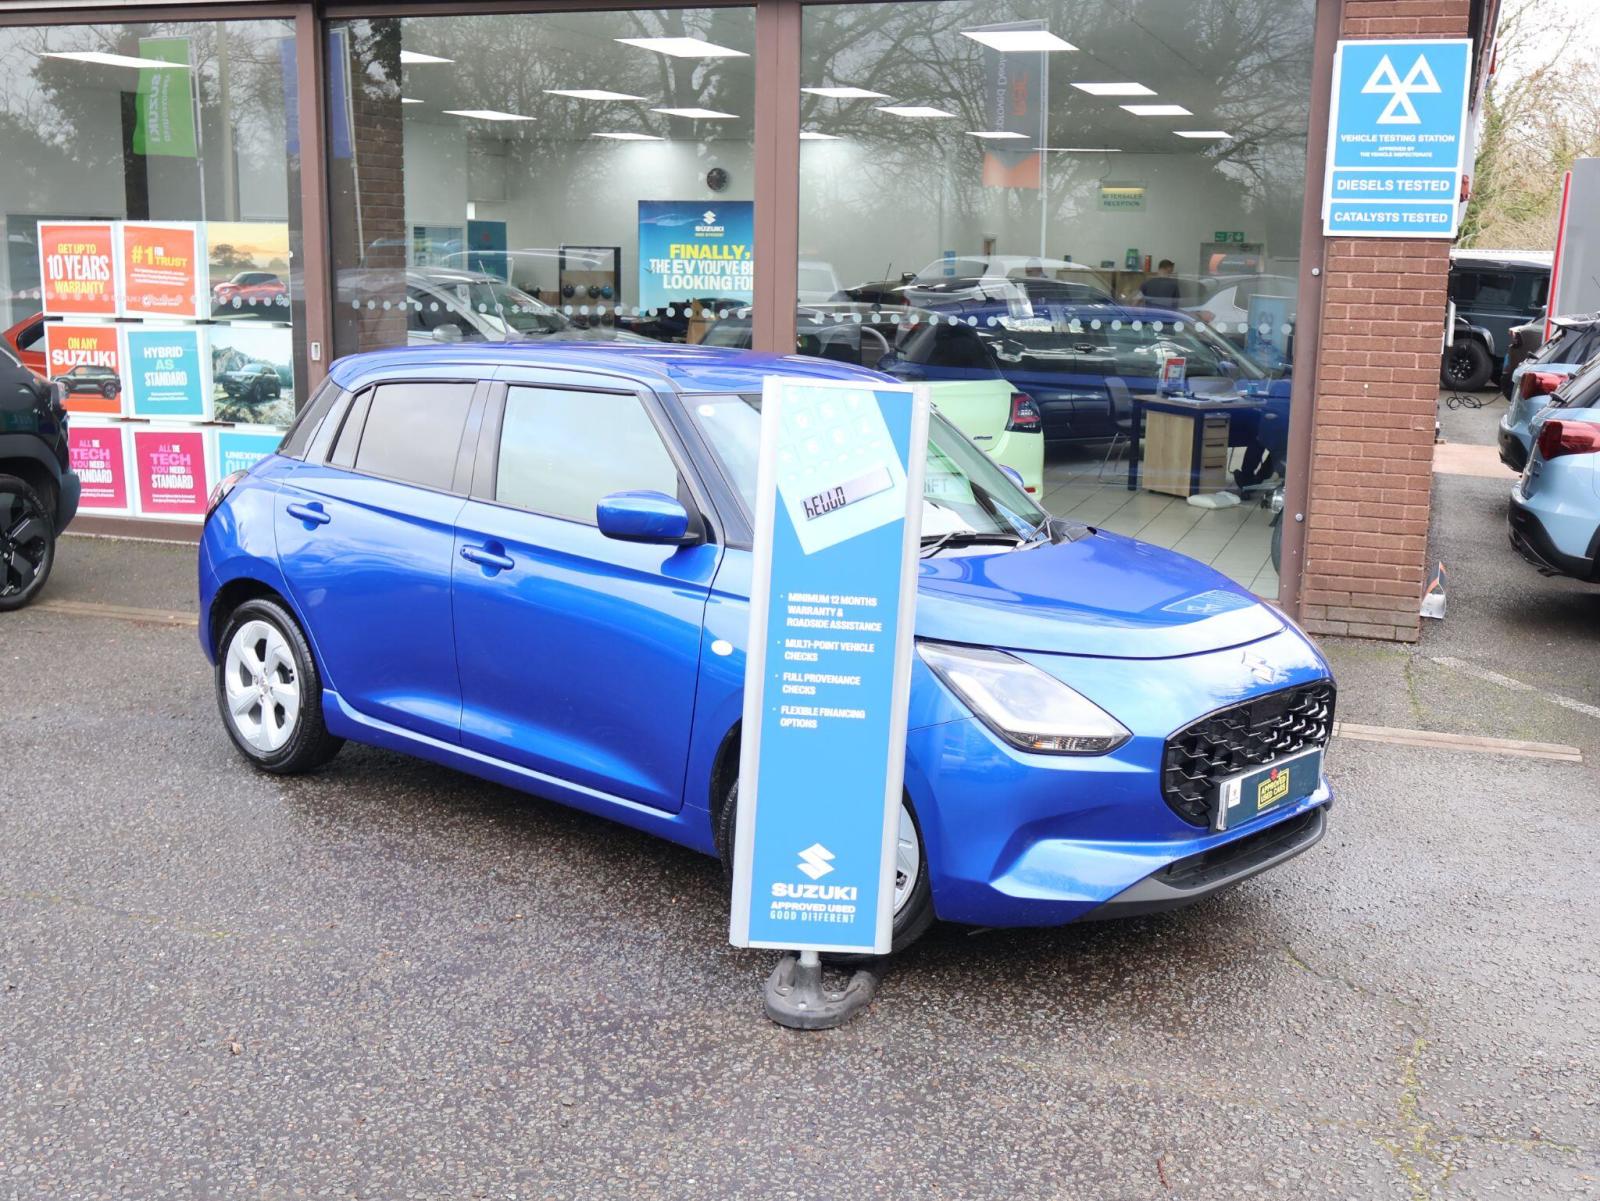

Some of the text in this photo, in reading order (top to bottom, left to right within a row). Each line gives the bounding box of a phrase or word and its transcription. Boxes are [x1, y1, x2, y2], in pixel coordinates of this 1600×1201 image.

[1341, 134, 1456, 143] VEHICLE TESTING STATION
[1337, 179, 1450, 192] DIESELS TESTED
[1334, 211, 1448, 222] CATALYSTS TESTED
[57, 243, 97, 254] GET UP TO
[131, 245, 154, 265] #1
[669, 244, 751, 260] FINALLY,
[47, 255, 64, 280] 10
[63, 255, 110, 280] YEARS
[154, 256, 188, 268] TRUST
[649, 259, 671, 274] THE
[672, 260, 696, 274] EV
[696, 260, 740, 275] YOU'VE
[54, 280, 105, 294] WARRANTY
[663, 275, 732, 290] LOOKING
[67, 337, 98, 350] ON ANY
[52, 349, 116, 367] SUZUKI
[143, 346, 183, 358] HYBRID
[155, 359, 174, 370] AS
[144, 371, 188, 387] STANDARD
[79, 440, 91, 448] ALL
[158, 444, 171, 452] ALL
[70, 448, 111, 460] TECH
[150, 453, 191, 465] TECH
[71, 460, 88, 469] YOU
[151, 465, 169, 474] YOU
[151, 474, 194, 489] STANDARD
[788, 593, 877, 607] MINIMUM 12 MONTHS
[787, 605, 843, 618] WARRANTY &
[787, 618, 882, 632] ROADSIDE ASSISTANCE
[785, 639, 875, 653] MULTI-POINT VEHICLE
[784, 651, 818, 661] CHECKS
[783, 672, 861, 685] FULL PROVENANCE
[782, 685, 816, 695] CHECKS
[781, 705, 866, 719] FLEXIBLE FINANCING
[780, 718, 817, 729] OPTIONS
[771, 882, 858, 901] SUZUKI
[770, 901, 856, 913] APPROVED USED
[770, 910, 797, 921] GOOD
